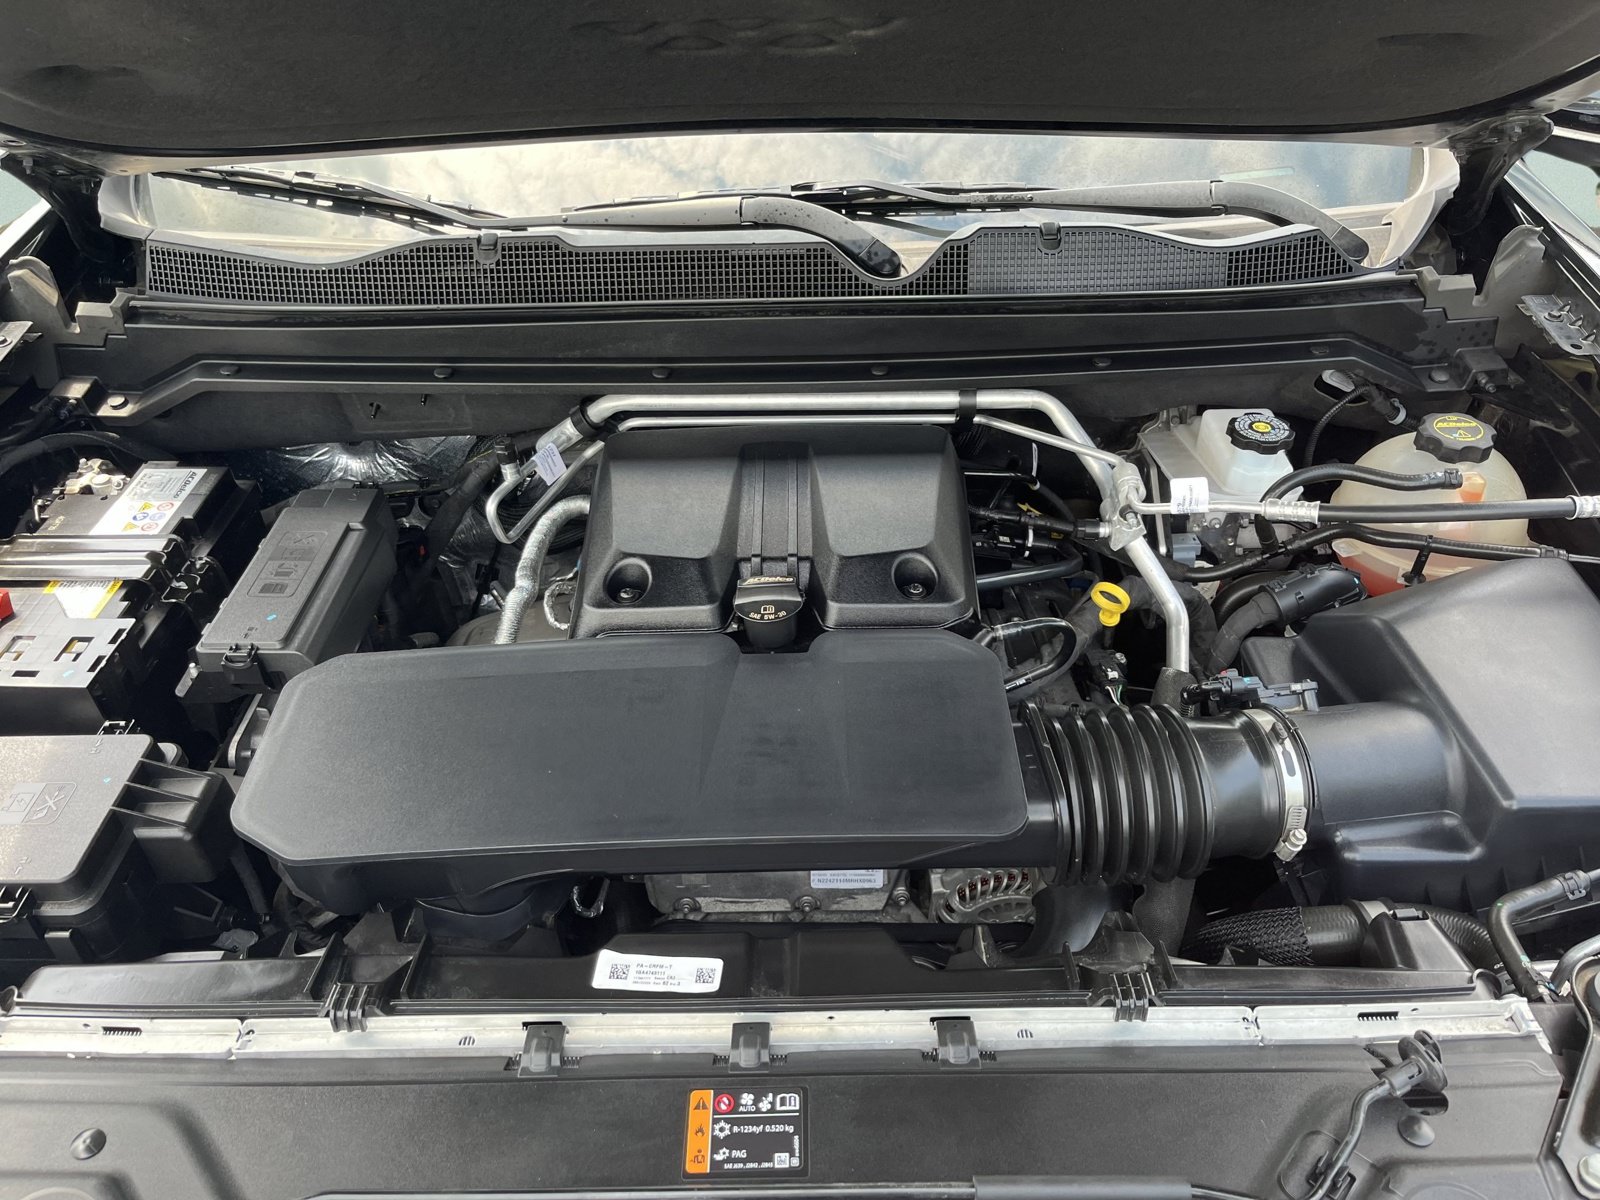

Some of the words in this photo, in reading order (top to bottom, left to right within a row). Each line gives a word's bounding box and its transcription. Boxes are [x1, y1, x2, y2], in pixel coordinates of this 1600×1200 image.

[173, 471, 198, 499] ACDelco
[743, 576, 794, 585] ACDelco
[748, 612, 762, 620] SAE
[763, 610, 787, 620] 5W-30
[733, 1125, 763, 1134] R-1234yf
[784, 1124, 794, 1134] kg
[731, 1150, 747, 1158] PAG
